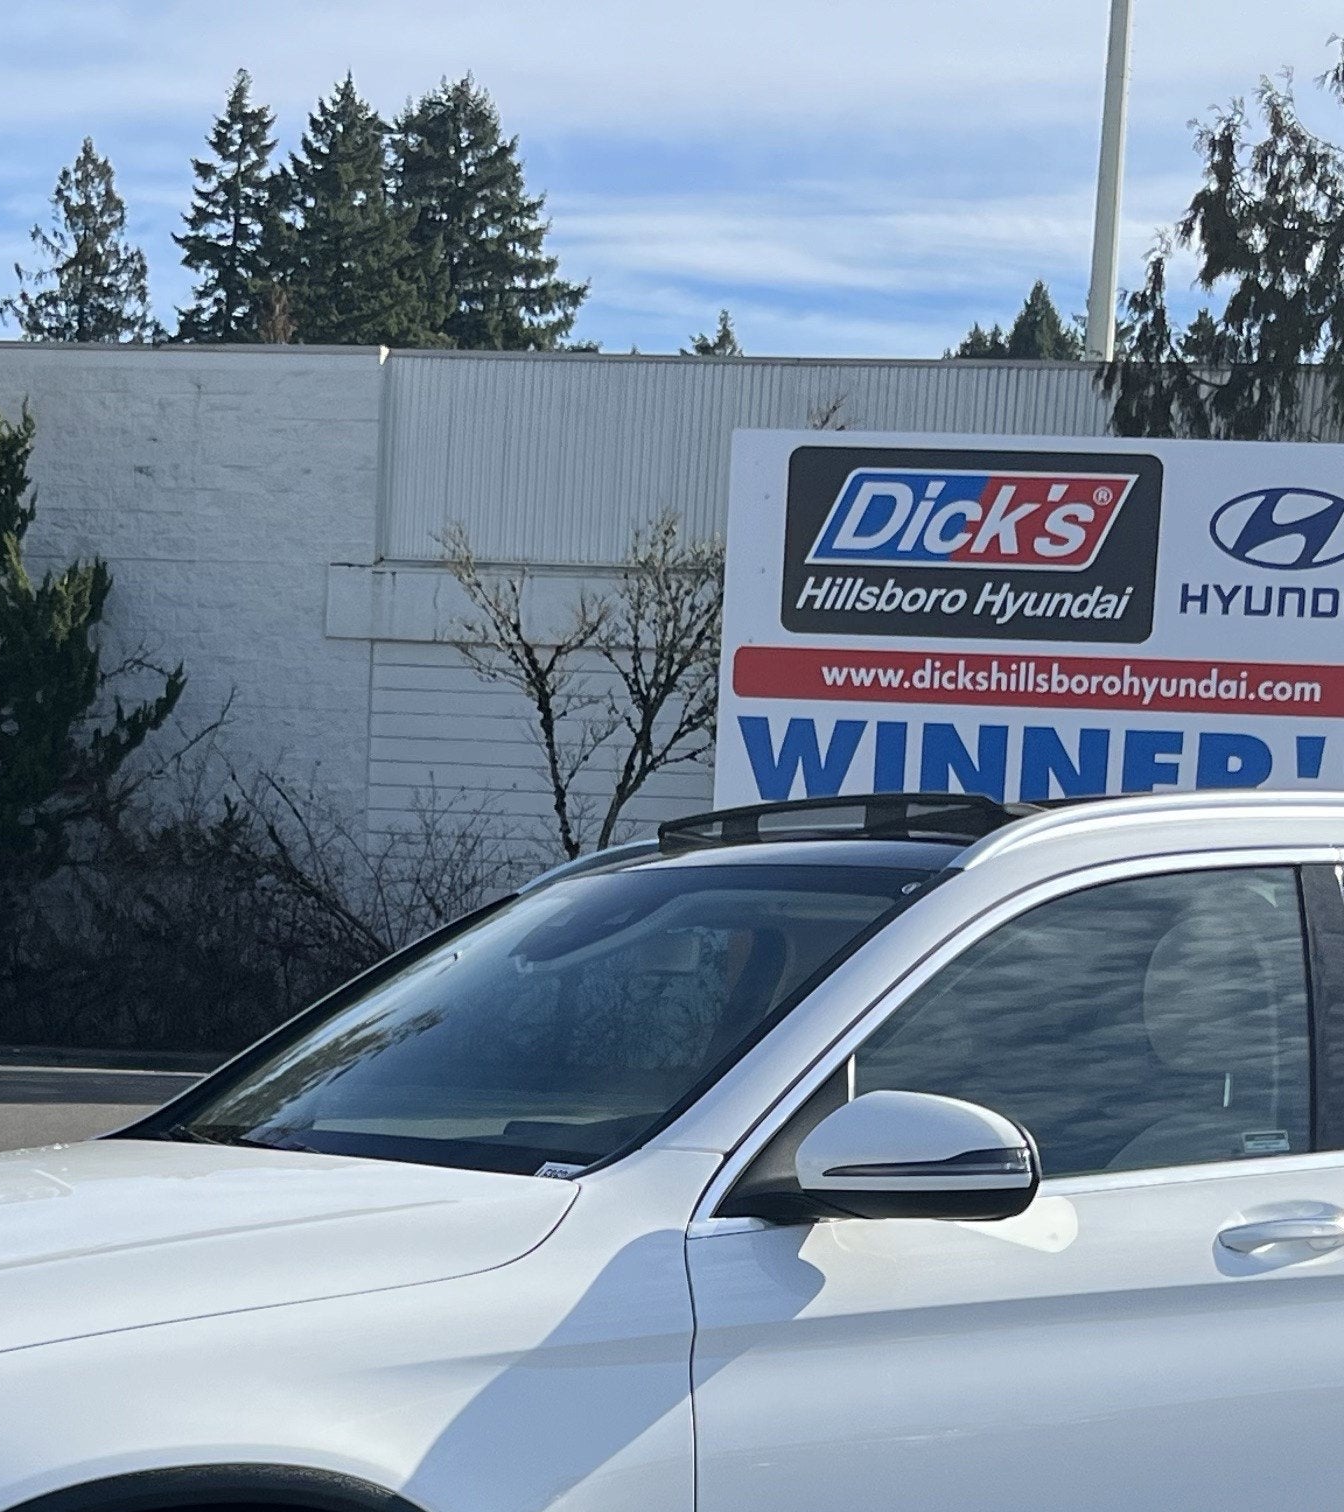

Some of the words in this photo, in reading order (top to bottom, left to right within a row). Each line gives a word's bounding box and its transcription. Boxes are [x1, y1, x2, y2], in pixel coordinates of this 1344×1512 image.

[796, 577, 967, 615] Hillsboro
[973, 582, 1133, 625] Hyundai
[821, 661, 1322, 704] www.dickshillsborohyundai.com
